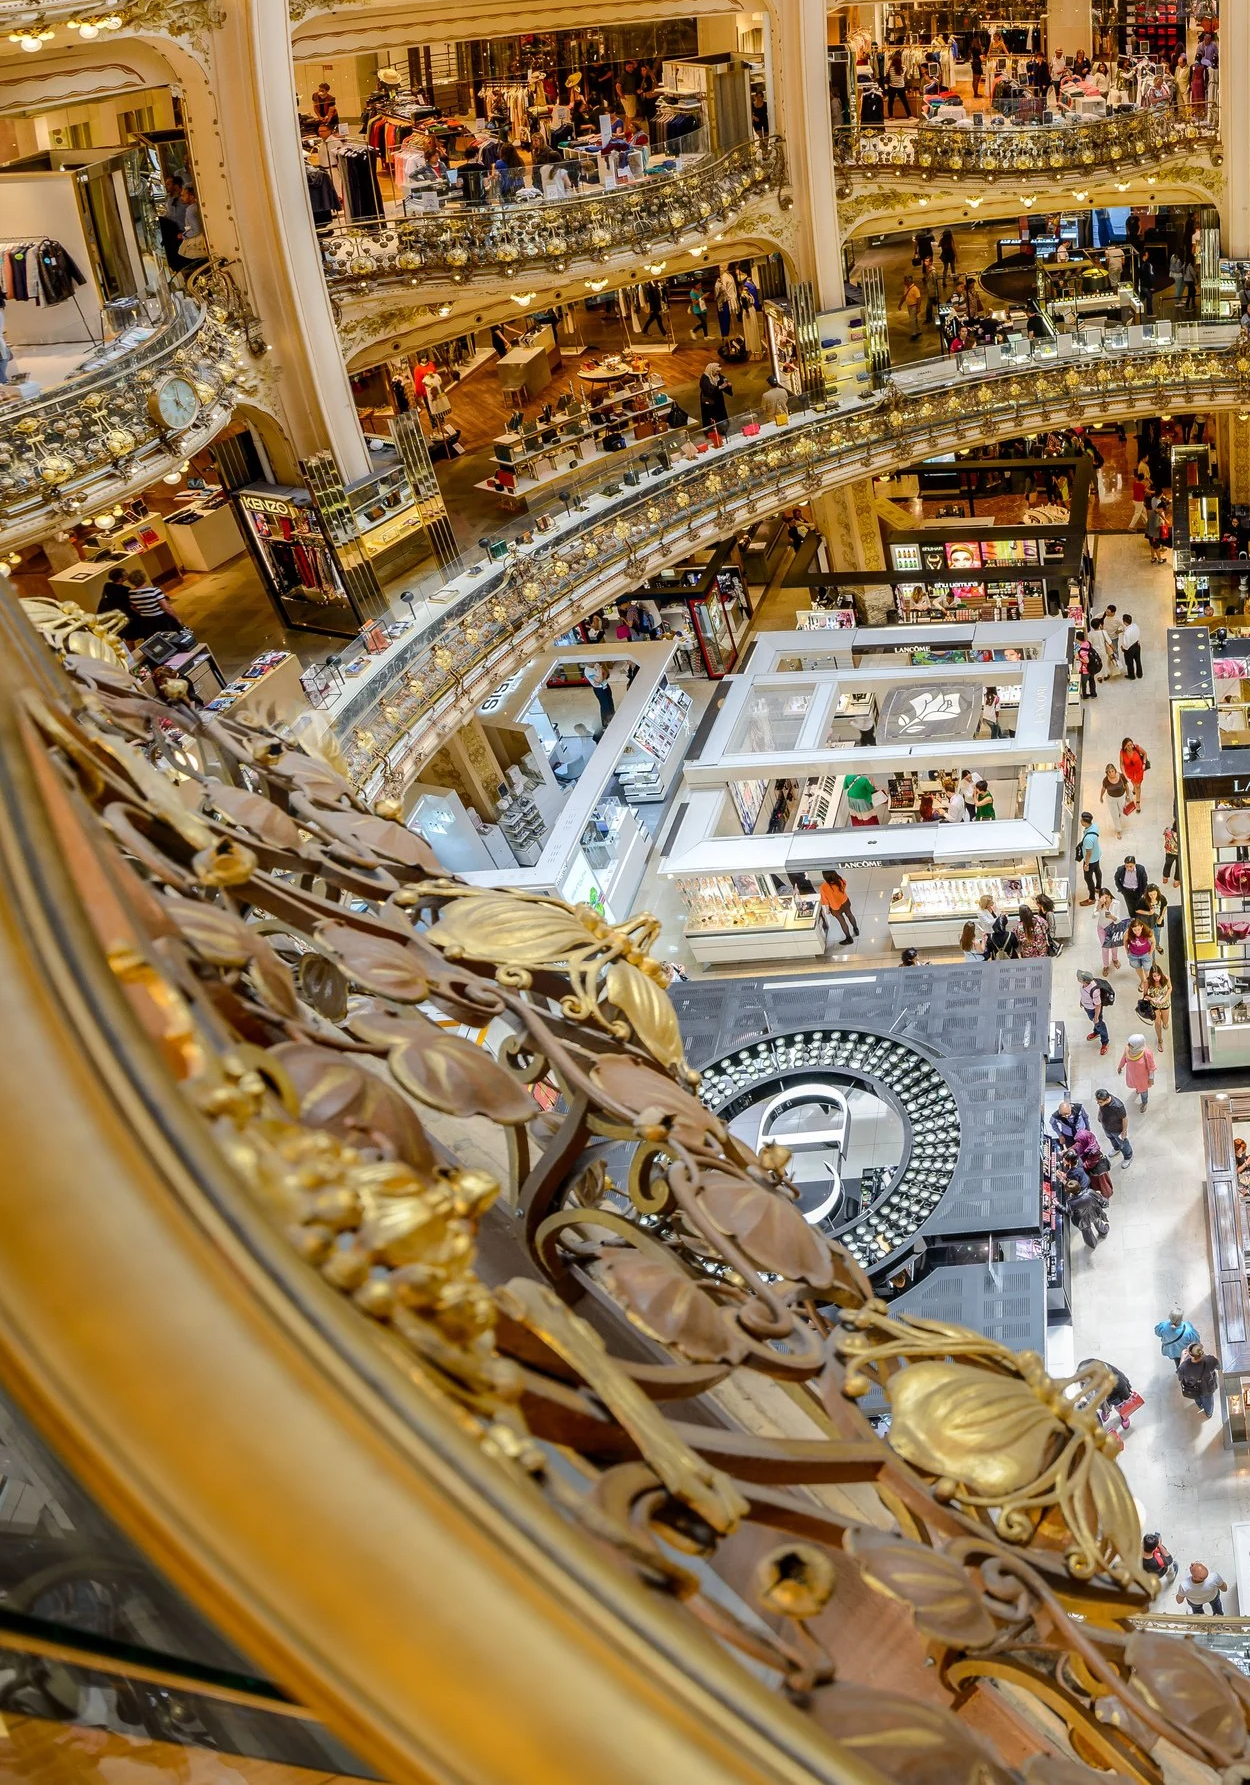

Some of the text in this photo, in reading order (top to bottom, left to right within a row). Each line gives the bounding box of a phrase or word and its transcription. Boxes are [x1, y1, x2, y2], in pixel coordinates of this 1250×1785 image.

[243, 496, 289, 515] KENZO
[894, 645, 931, 653] LANCÔME
[838, 860, 882, 869] LANCÔME
